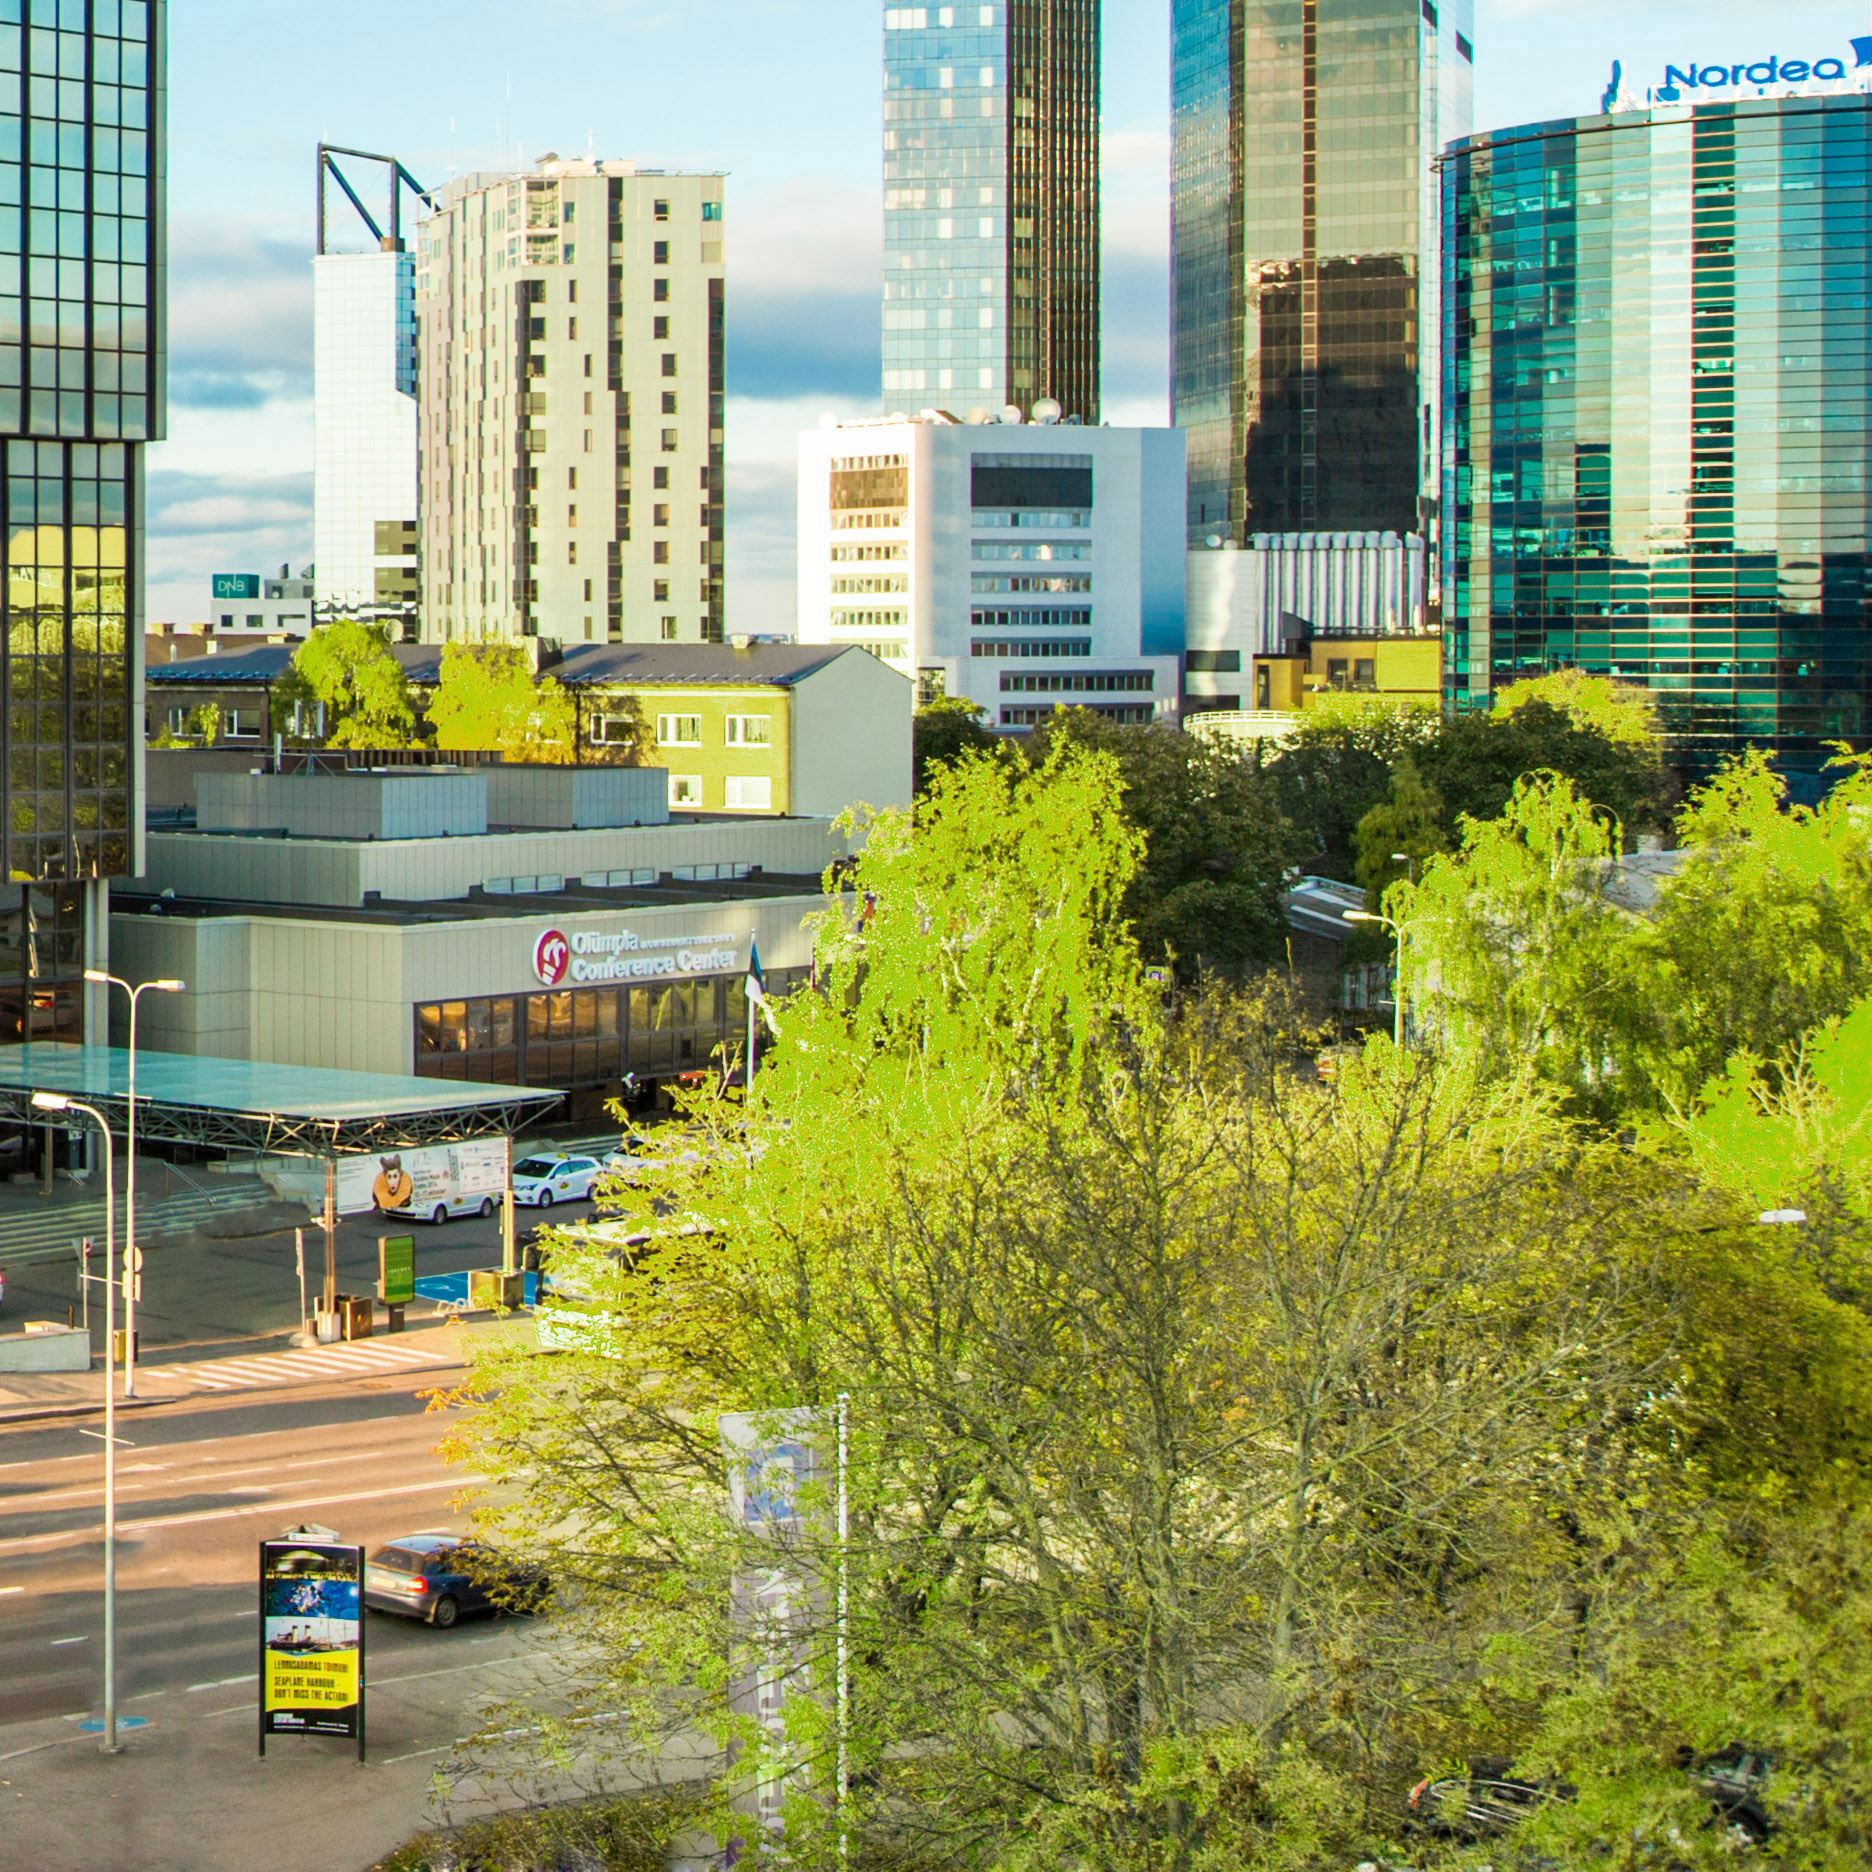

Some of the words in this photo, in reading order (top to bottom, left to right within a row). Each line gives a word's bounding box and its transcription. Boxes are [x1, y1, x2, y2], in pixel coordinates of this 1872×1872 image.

[1664, 55, 1846, 88] Nordea
[571, 929, 639, 957] Olümpia
[571, 954, 675, 982] Conference
[676, 947, 738, 972] Center
